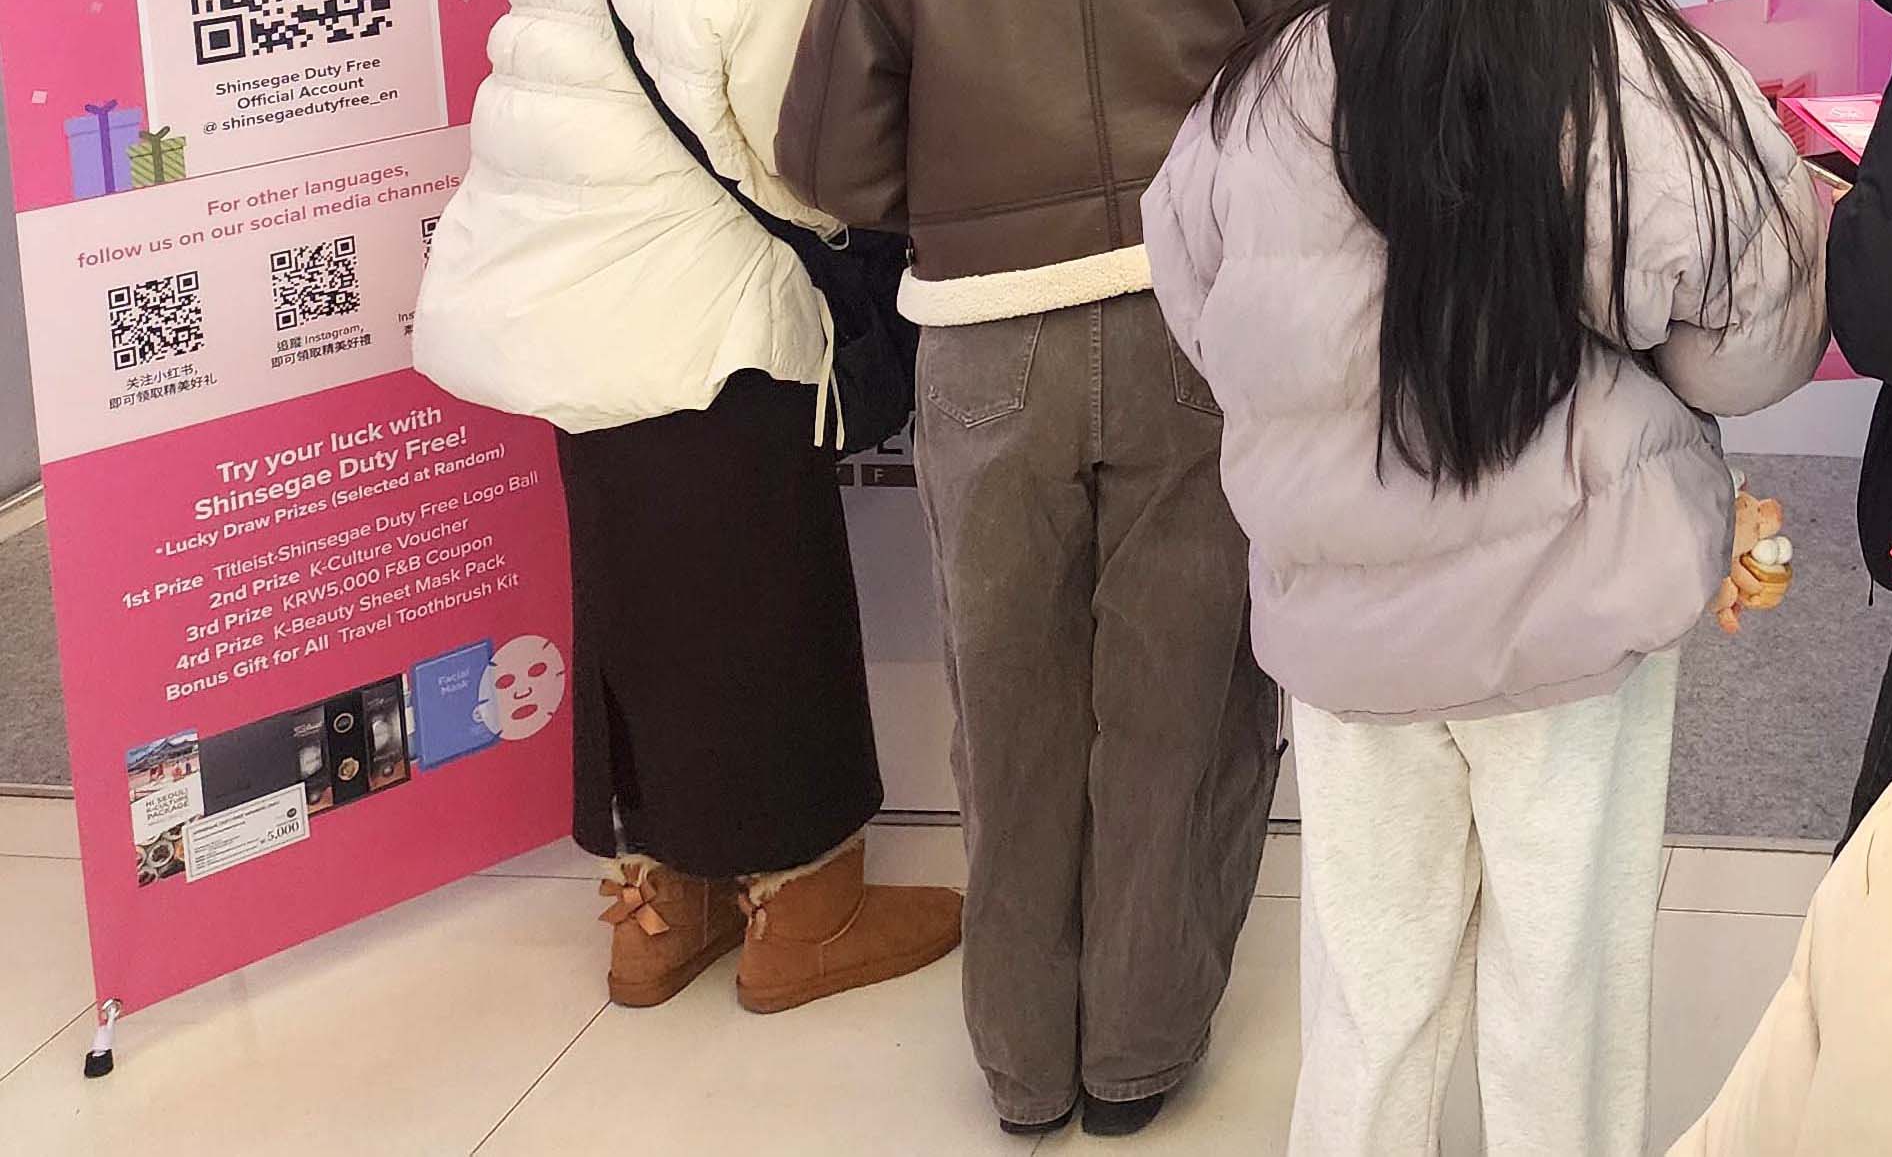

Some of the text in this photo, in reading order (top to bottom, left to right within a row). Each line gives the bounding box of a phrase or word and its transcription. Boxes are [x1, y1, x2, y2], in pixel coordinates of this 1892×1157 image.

[202, 88, 399, 135] @ shinsegaedutyfree_en
[215, 56, 381, 95] Shinsegae Duty Free
[237, 76, 364, 110] Official Account
[78, 174, 460, 269] follow us on our social media channels
[207, 164, 409, 216] For other languages,
[194, 425, 467, 520] Shinsegae Duty Free!
[216, 406, 441, 483] Try your luck with
[122, 589, 150, 609] 1st
[154, 574, 204, 599] Prize
[375, 509, 416, 533] Duty
[420, 497, 459, 519] Free
[463, 483, 504, 505] Logo
[508, 470, 538, 492] Ball
[165, 443, 505, 556] Lucky Draw Prizes (Selected at Random)
[185, 620, 220, 642] 3rd
[224, 604, 273, 630] Prize
[385, 555, 421, 579] F&B
[426, 535, 493, 565] Coupon
[208, 517, 469, 609] 2nd Prize K-Culture Voucher
[166, 572, 520, 701] Bonus Gift for All Travel Toothbrush Kit
[176, 553, 506, 670] 4rd Prize K-Beauty Sheet Mask Pack
